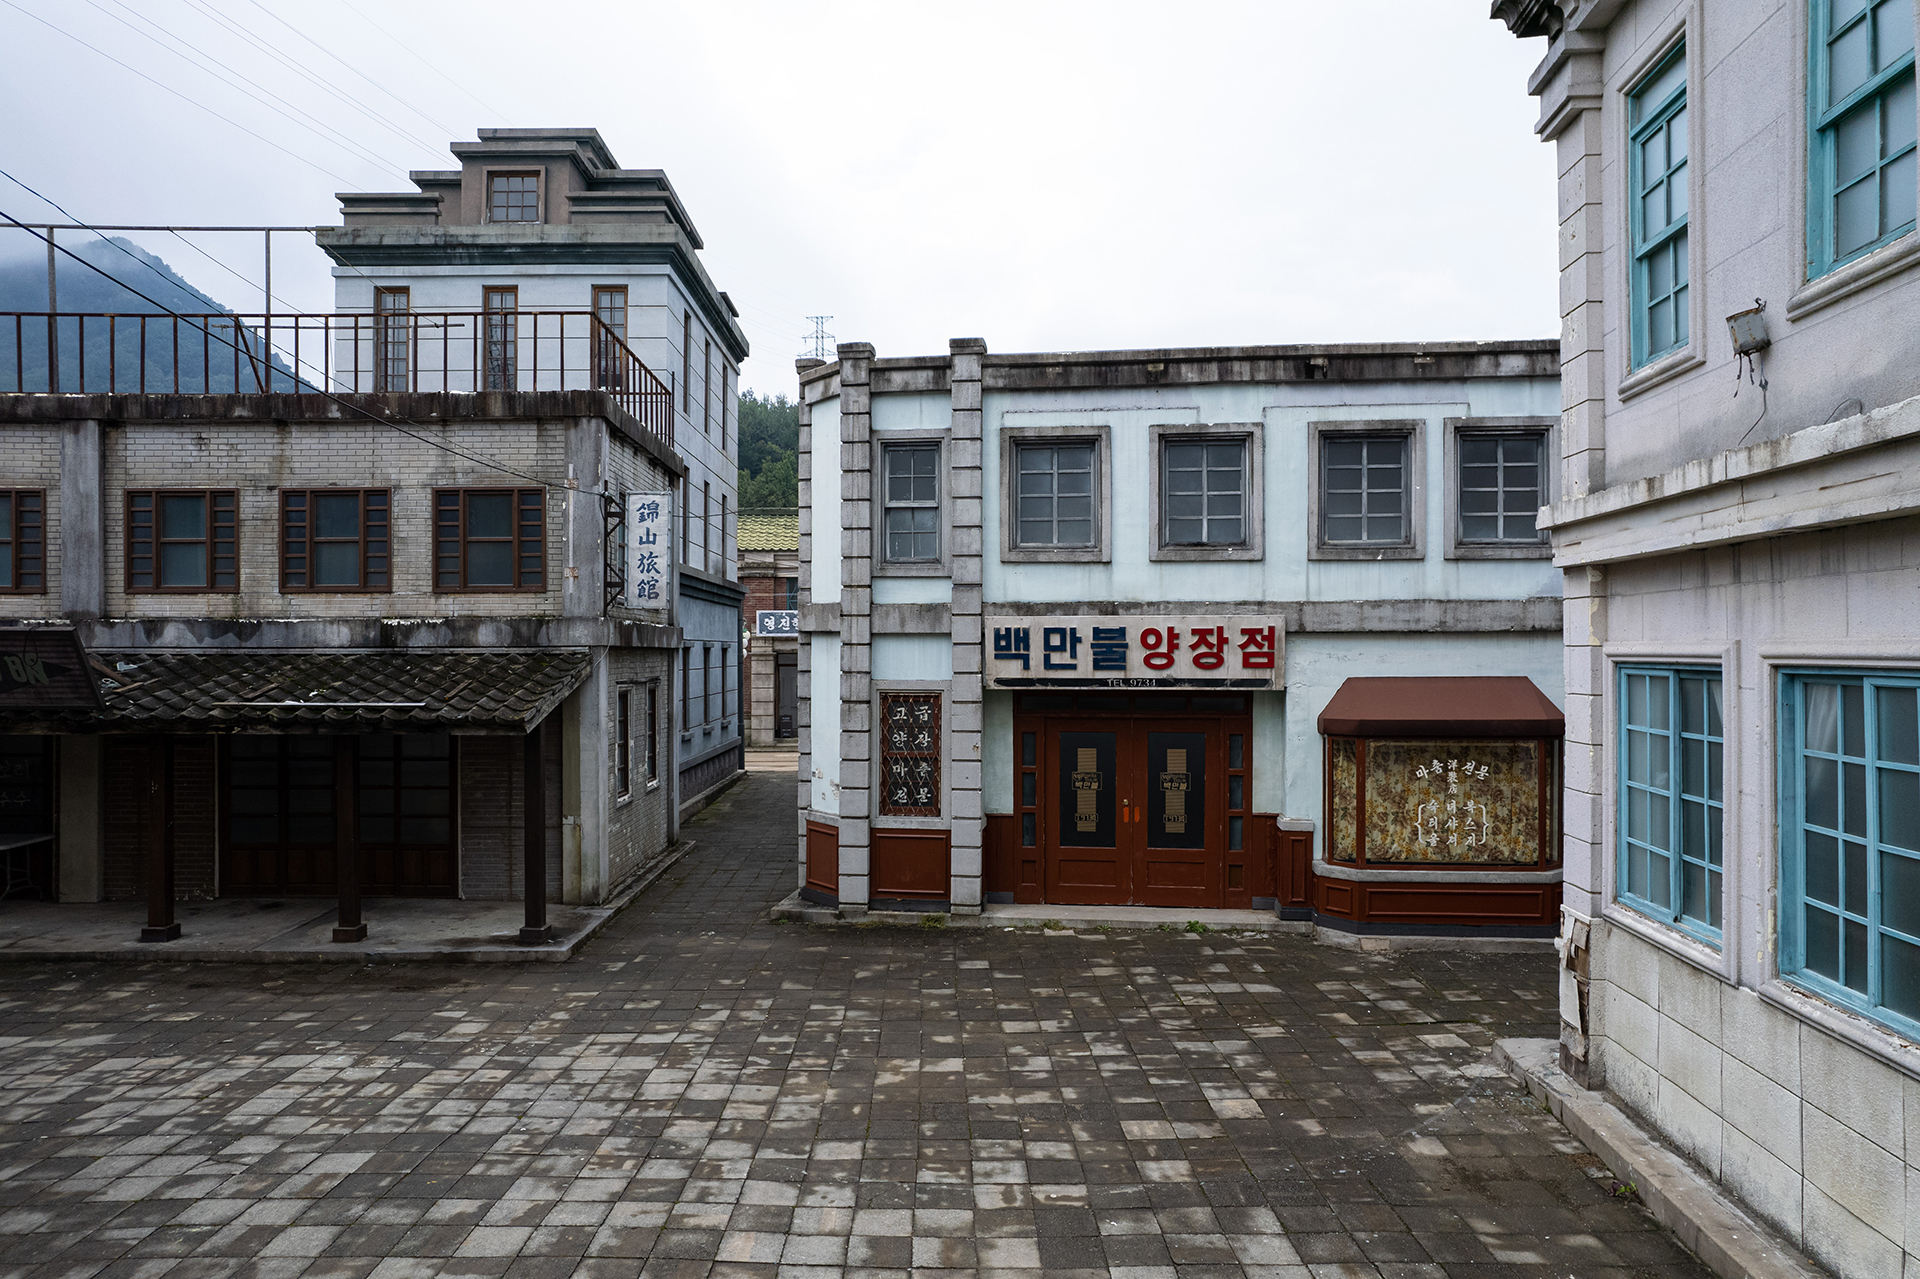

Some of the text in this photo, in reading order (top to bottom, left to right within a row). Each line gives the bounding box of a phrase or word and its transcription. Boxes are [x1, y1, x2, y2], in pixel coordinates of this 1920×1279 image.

[636, 500, 661, 600] 錦山旅館
[1130, 679, 1156, 687] 9734
[892, 706, 931, 721] 고급
[892, 731, 931, 747] 양장
[1461, 760, 1490, 780] 전문
[893, 786, 931, 804] 전문
